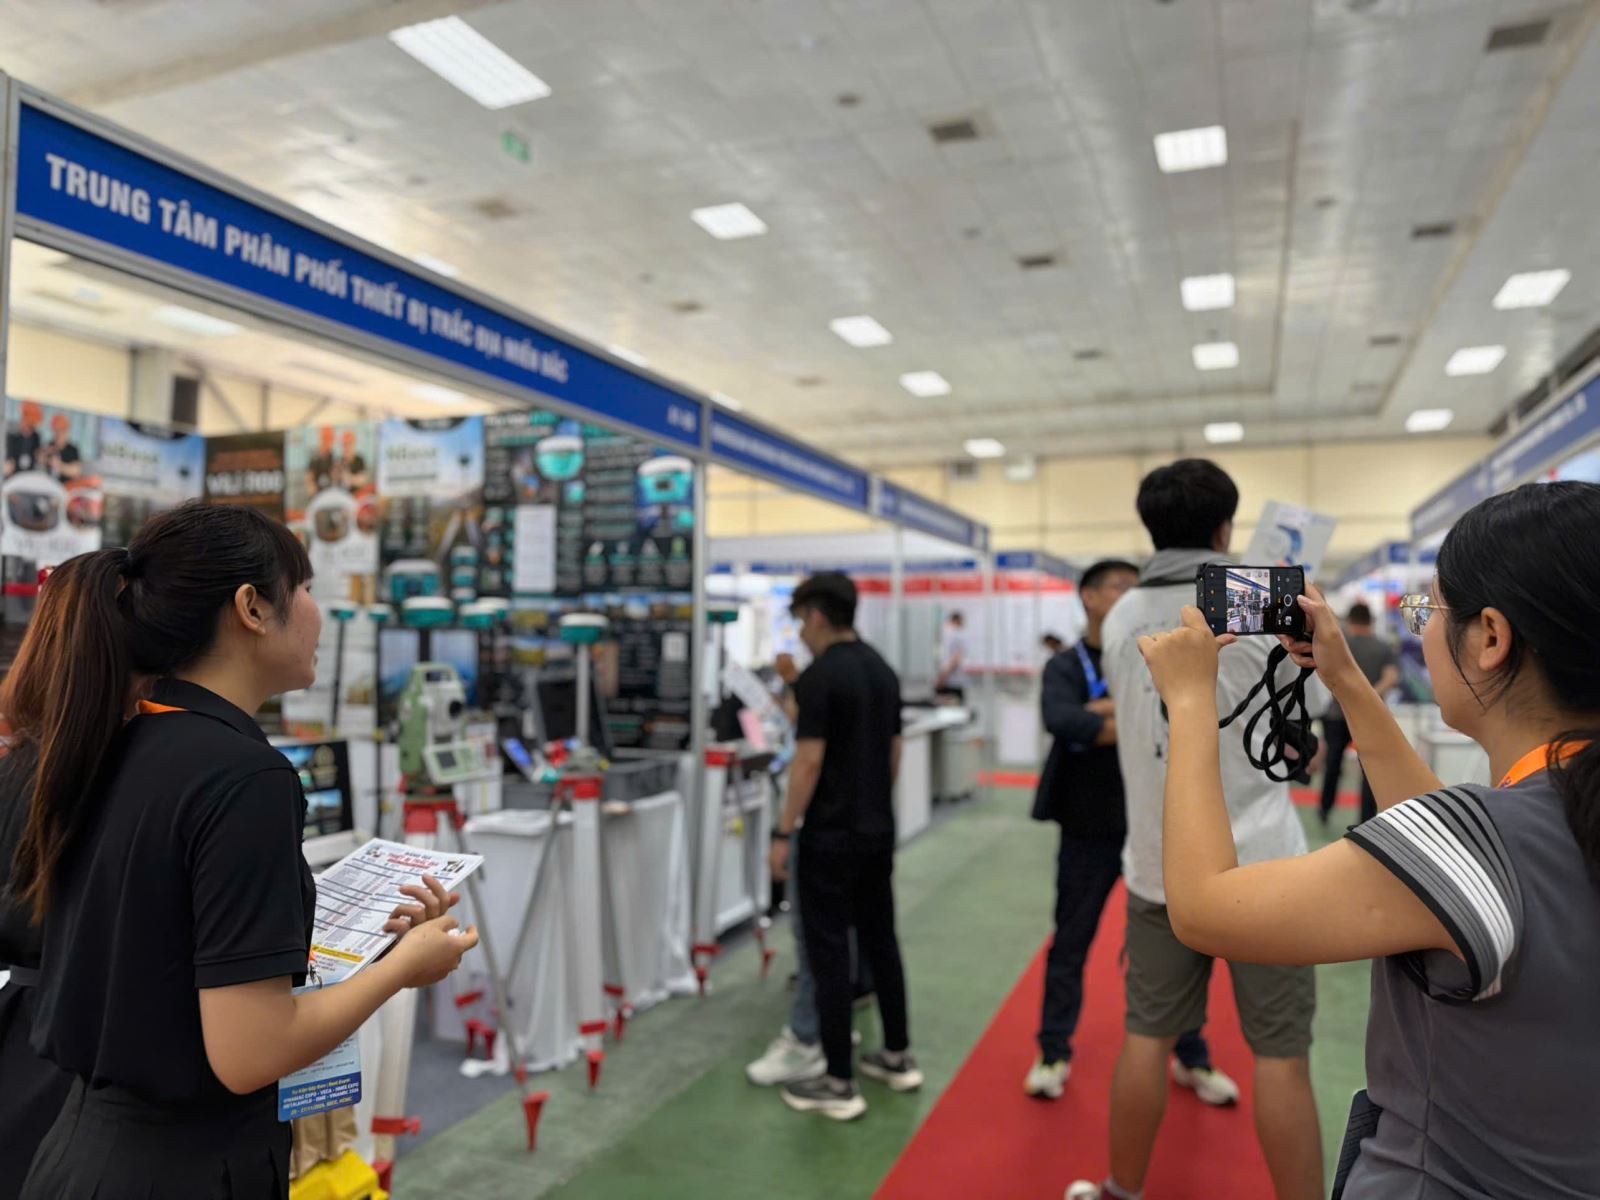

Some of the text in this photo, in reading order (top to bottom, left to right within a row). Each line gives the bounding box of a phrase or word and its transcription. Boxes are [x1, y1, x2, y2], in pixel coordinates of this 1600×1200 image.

[45, 152, 151, 225] TRUNG
[157, 197, 218, 251] TÂM
[224, 224, 291, 277] PHÂN
[294, 251, 348, 299] PHỐI
[351, 274, 406, 320] THIẾT
